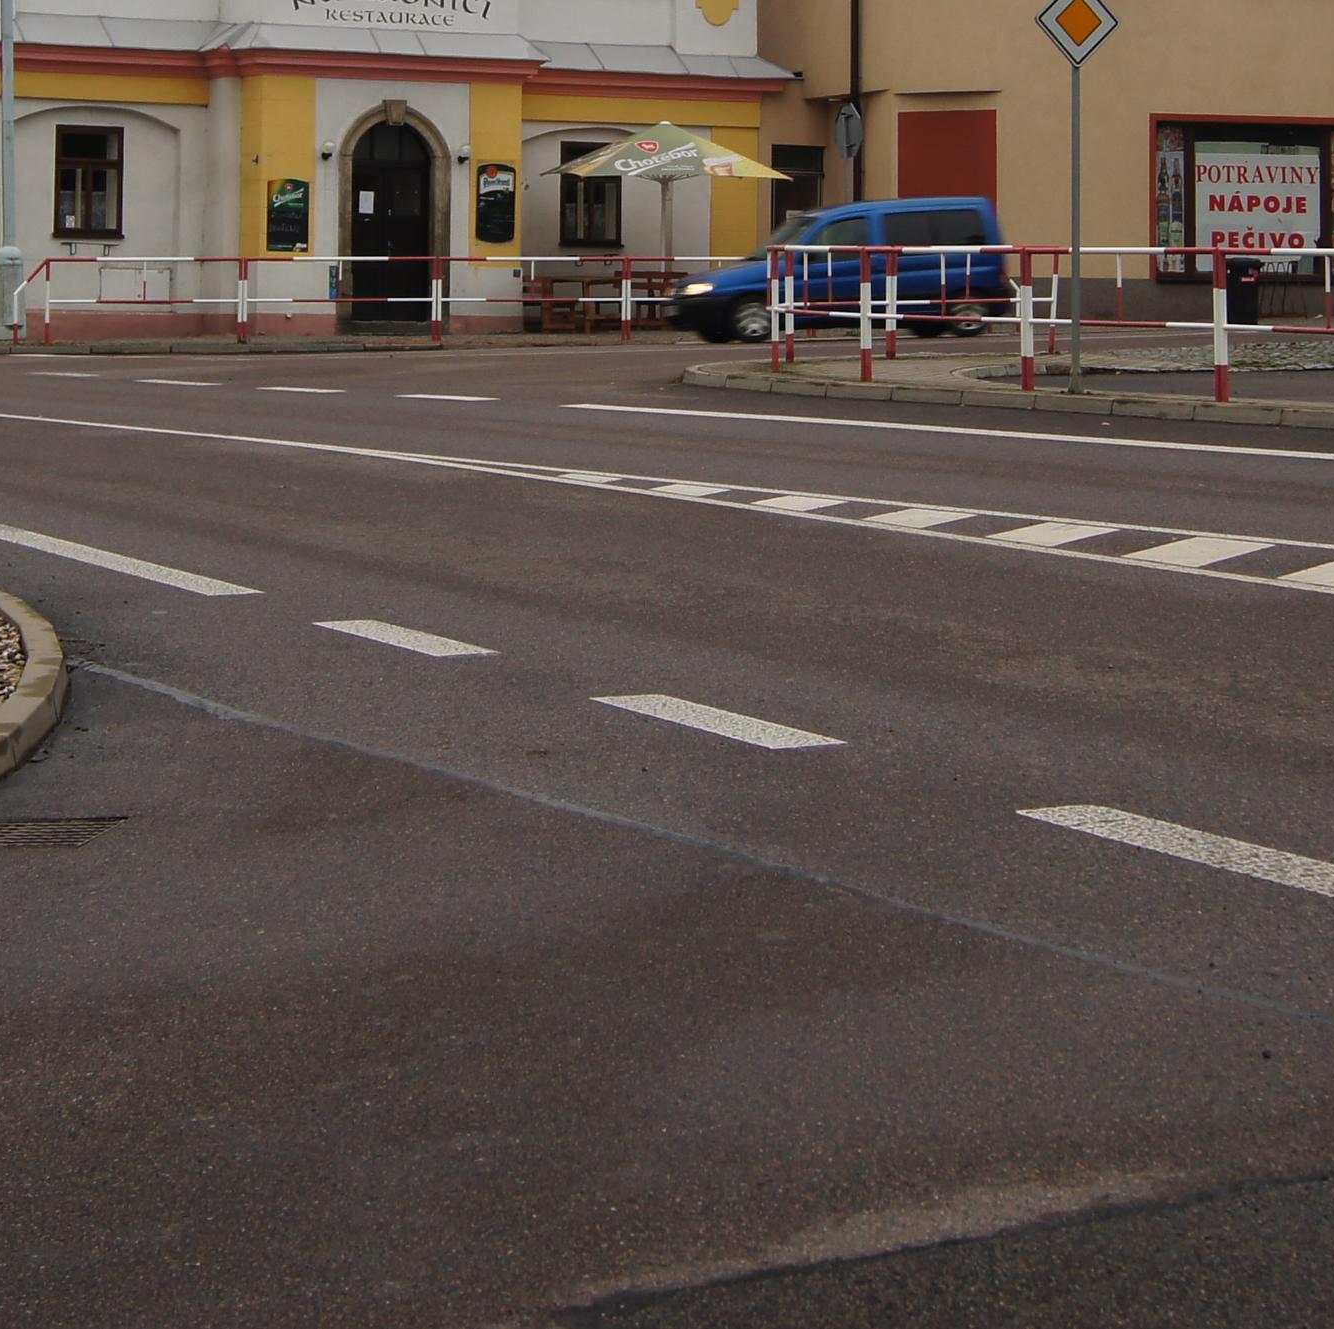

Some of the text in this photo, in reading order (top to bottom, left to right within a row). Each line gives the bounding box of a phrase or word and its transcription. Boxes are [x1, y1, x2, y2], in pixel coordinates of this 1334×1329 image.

[326, 8, 455, 27] RESTAURACE
[1195, 164, 1320, 185] POTRAVINY
[1209, 190, 1307, 214] NÁPOJE
[1211, 226, 1305, 248] PEČIVO
